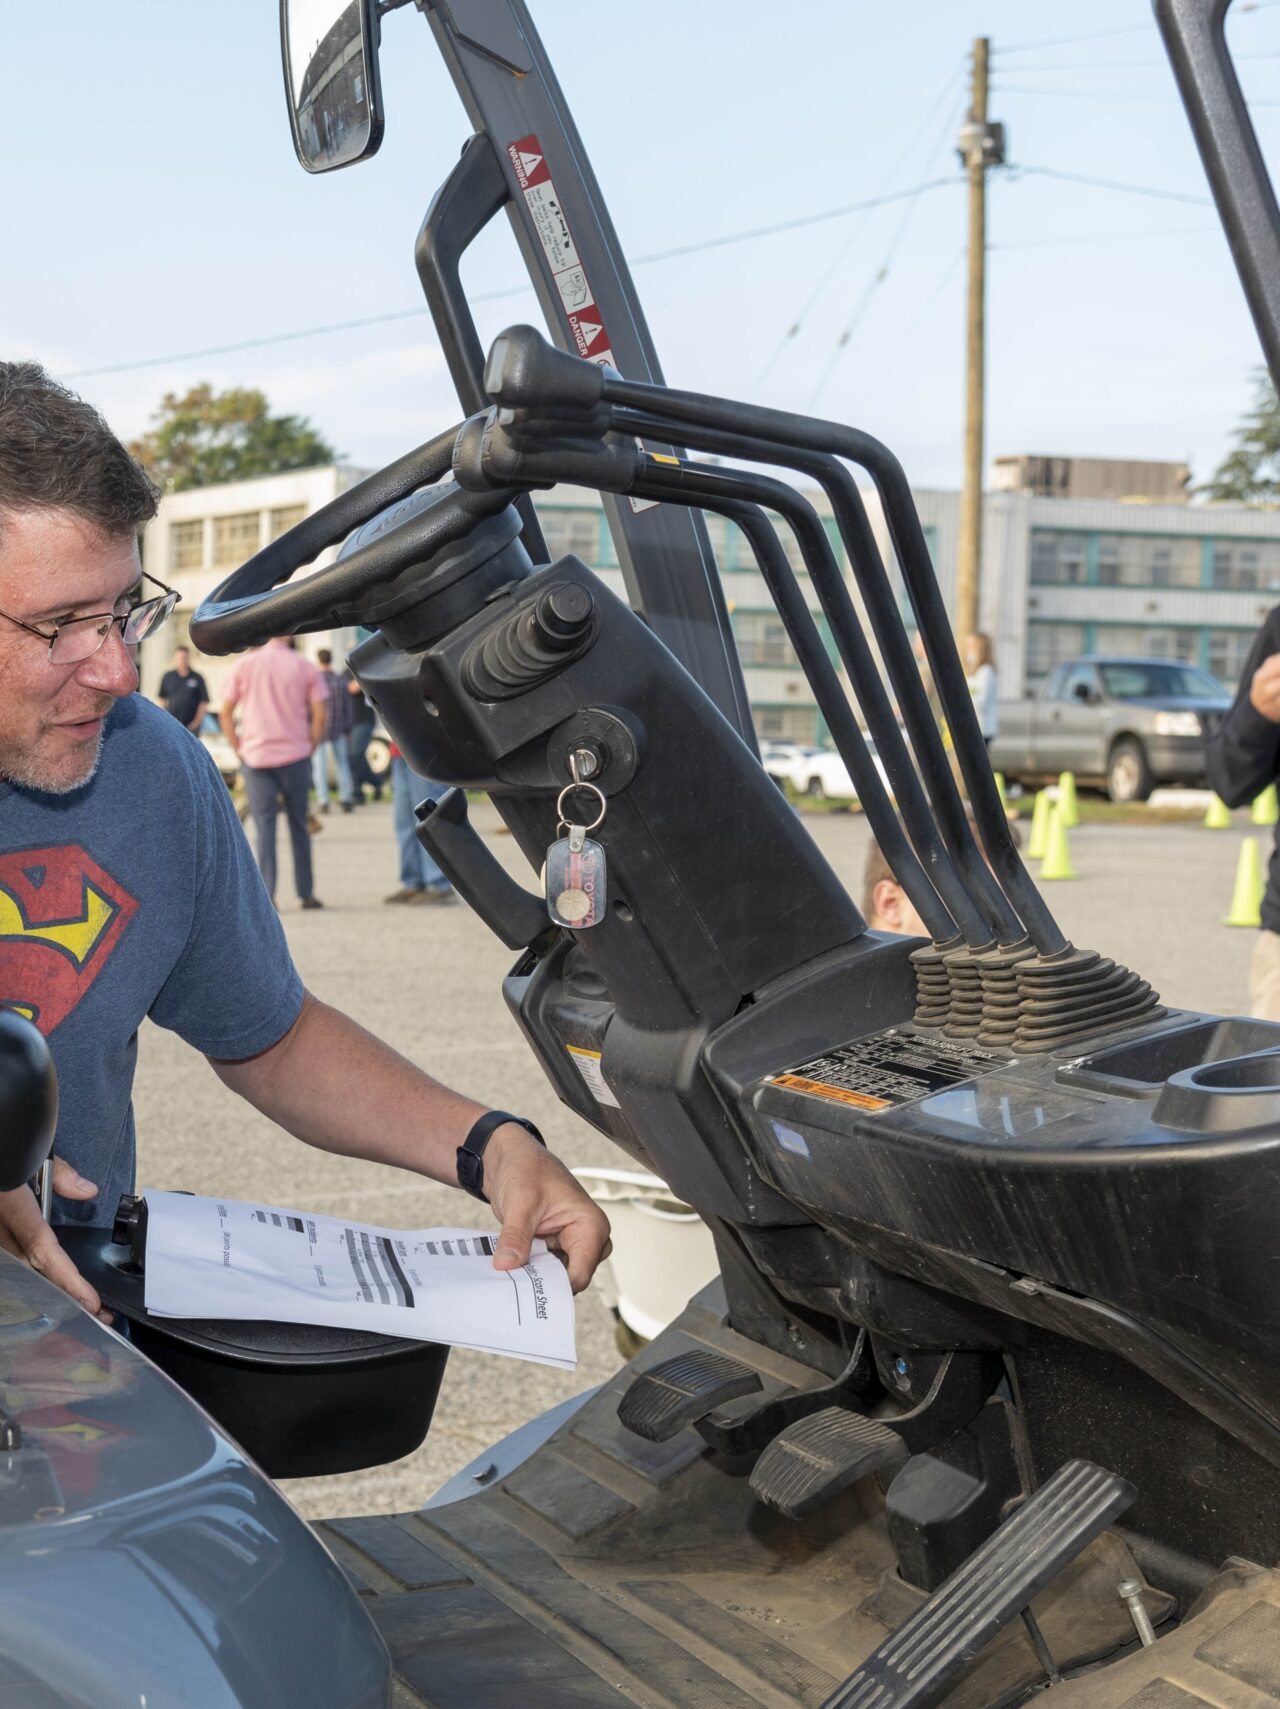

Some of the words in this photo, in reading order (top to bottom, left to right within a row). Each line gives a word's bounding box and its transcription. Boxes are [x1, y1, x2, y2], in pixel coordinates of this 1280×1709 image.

[508, 145, 528, 188] WARNING
[568, 316, 588, 356] DANGER
[533, 1277, 544, 1295] Score
[536, 1295, 548, 1320] Sheet
